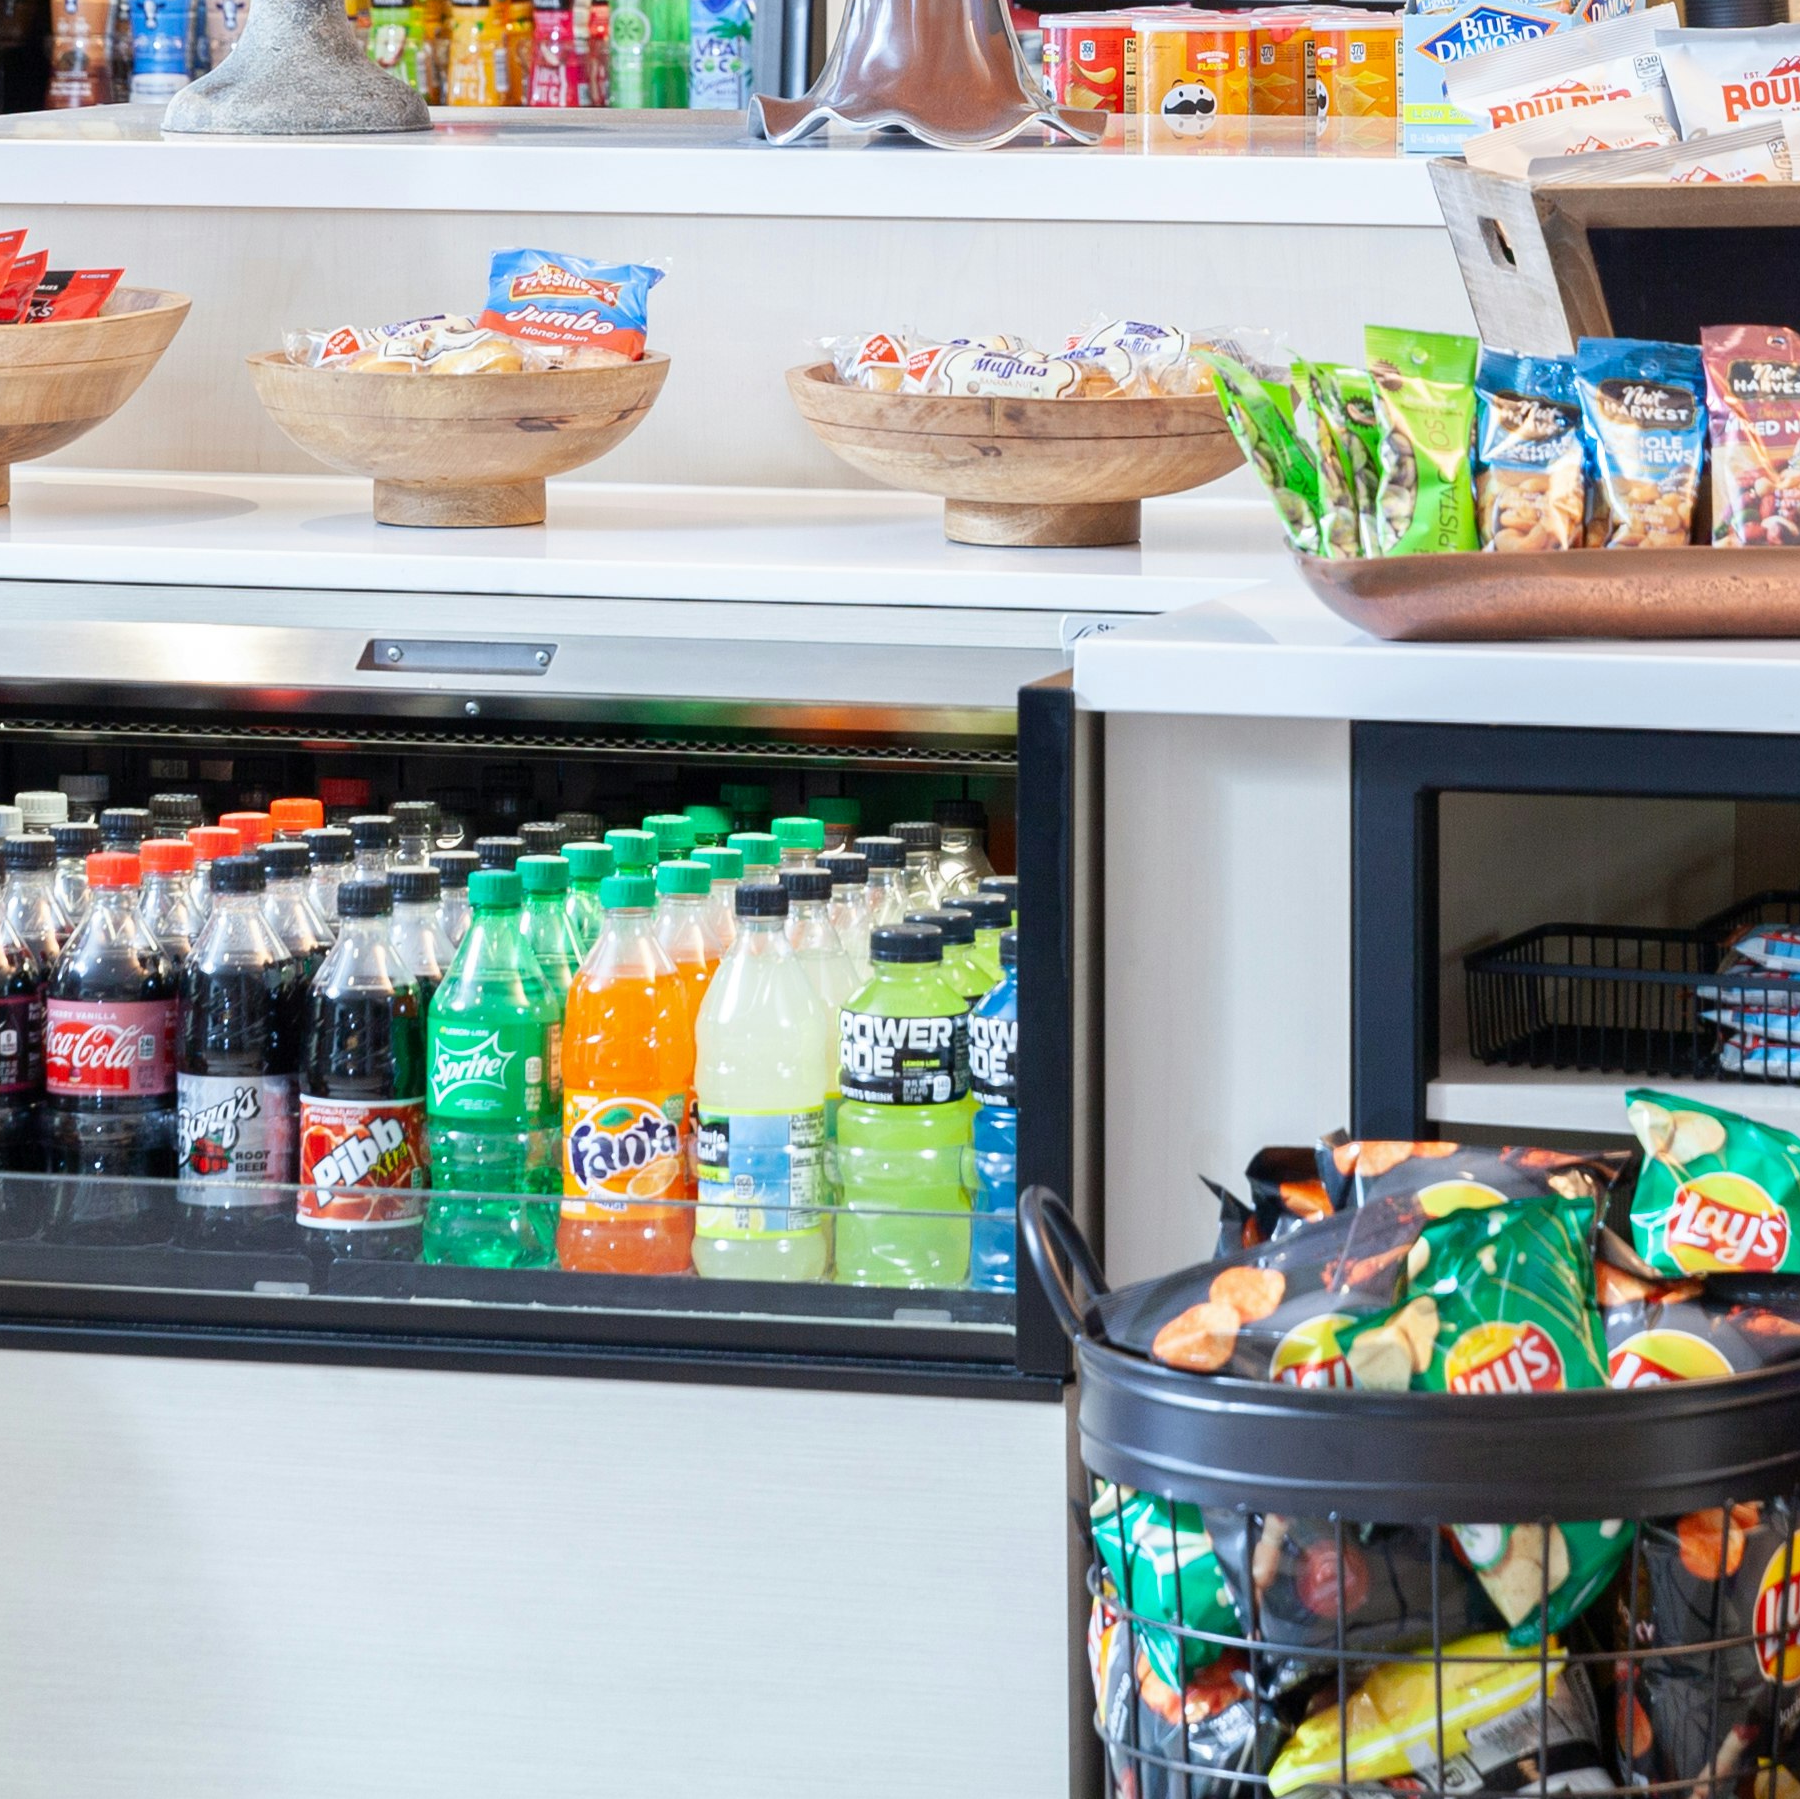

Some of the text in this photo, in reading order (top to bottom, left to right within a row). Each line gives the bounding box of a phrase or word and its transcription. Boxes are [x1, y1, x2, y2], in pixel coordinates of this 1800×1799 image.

[1460, 14, 1514, 40] BLUE
[694, 37, 736, 58] VITA
[1260, 44, 1274, 57] 370
[1350, 43, 1365, 56] 370
[1197, 62, 1229, 71] FLAVOR
[1636, 54, 1658, 66] 230
[1743, 71, 1764, 80] EST.
[505, 303, 615, 335] Jumbo
[520, 326, 589, 343] Honey Bun
[973, 358, 1049, 380] Muffins
[1749, 361, 1798, 384] Nut
[1622, 385, 1669, 407] Nut
[1604, 399, 1690, 422] HARVEST
[74, 1010, 117, 1021] VANILLA
[839, 1010, 953, 1050] POWER
[433, 1051, 503, 1087] Sprite
[235, 1151, 270, 1161] ROOT
[570, 1112, 680, 1187] Fanta
[235, 1162, 268, 1173] BEER
[311, 1115, 404, 1210] Pibb
[1665, 1190, 1791, 1264] Lay's
